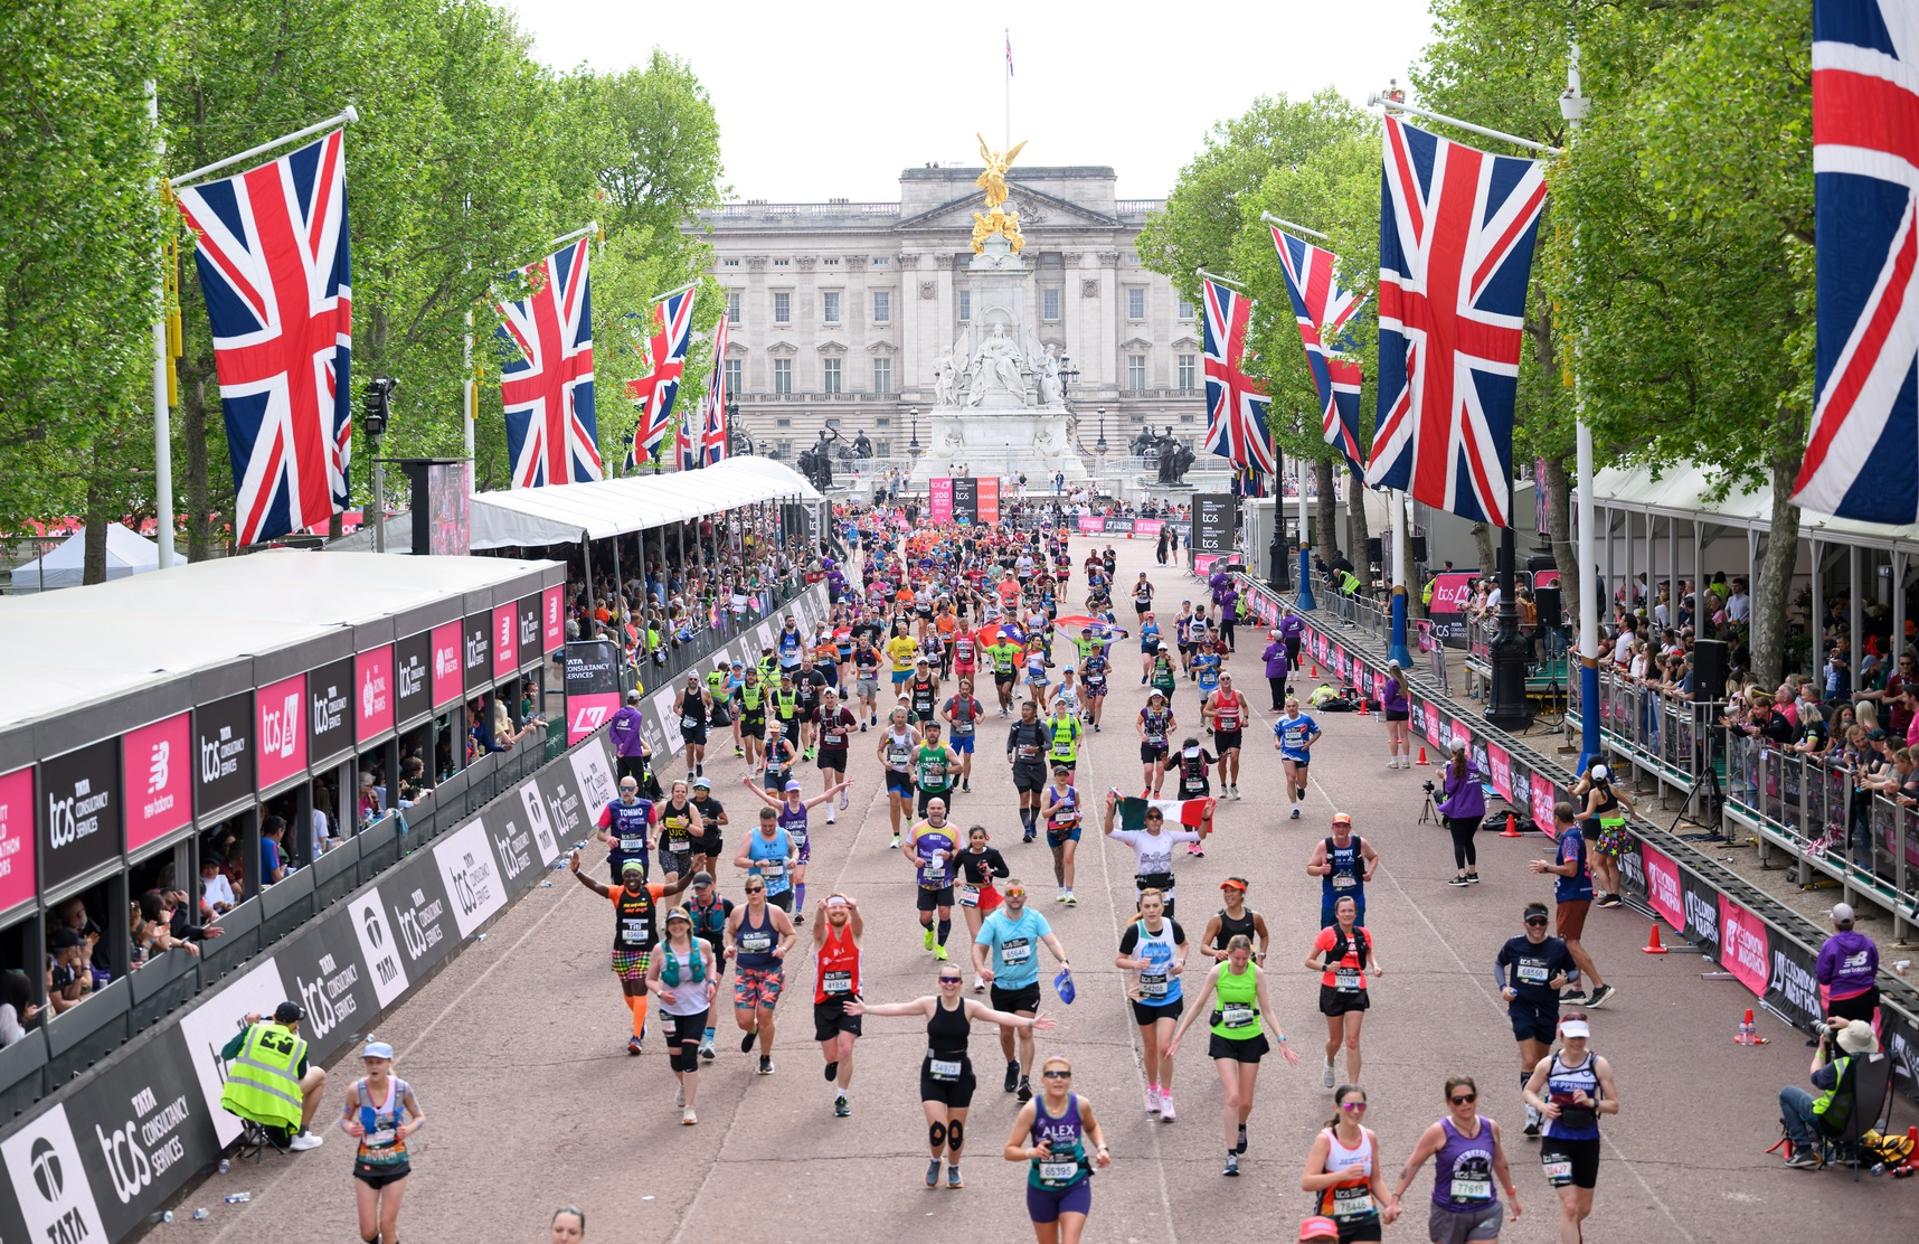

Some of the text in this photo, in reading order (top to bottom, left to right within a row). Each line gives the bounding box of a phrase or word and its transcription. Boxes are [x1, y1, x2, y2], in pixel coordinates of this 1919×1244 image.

[956, 492, 969, 500] tcs
[1203, 513, 1218, 523] tcs
[1203, 538, 1218, 549] tcs
[1438, 586, 1454, 601] tcs
[466, 636, 476, 669] tcs
[399, 661, 410, 699] tcs
[263, 704, 280, 755] tcs
[314, 692, 328, 736] tcs
[220, 726, 232, 741] TATA
[201, 735, 220, 784] tcs
[74, 778, 91, 798] TATA
[49, 792, 75, 849] tcs
[547, 794, 570, 836] tcs
[619, 808, 643, 817] TOMMO
[494, 832, 520, 880] tcs
[449, 866, 478, 916] tcs
[394, 905, 428, 960] tcs
[318, 953, 337, 976] TATA
[327, 963, 359, 1000] CONSULTANCY
[376, 957, 398, 987] TATA
[296, 976, 336, 1040] tcs
[335, 993, 356, 1023] SERVICES
[131, 1086, 157, 1118] TATA
[142, 1095, 189, 1147] CONSULTANCY
[1043, 1125, 1075, 1136] ALEX
[96, 1120, 152, 1204] tcs
[150, 1134, 184, 1177] SERVICES
[1045, 1167, 1071, 1176] 65395
[46, 1206, 88, 1244] TATA
